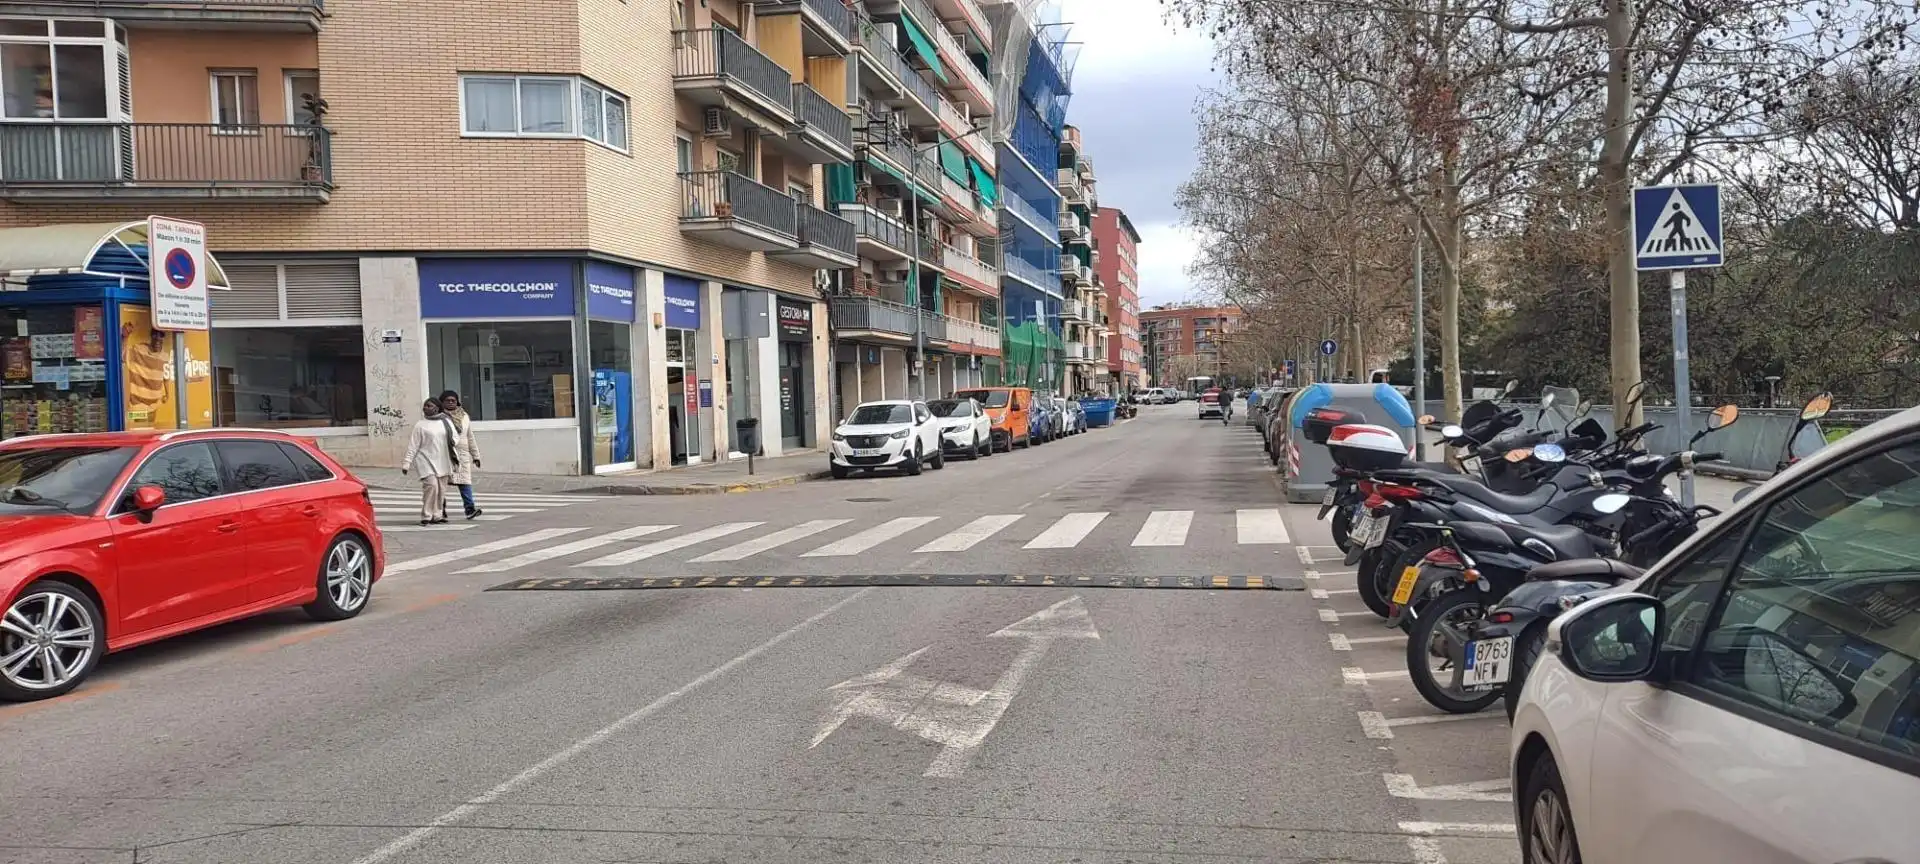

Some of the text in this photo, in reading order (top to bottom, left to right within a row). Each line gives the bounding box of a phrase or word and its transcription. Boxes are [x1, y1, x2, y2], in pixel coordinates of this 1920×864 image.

[439, 282, 554, 293] TCC THECOLCHON
[589, 284, 600, 294] TCC
[780, 305, 802, 320] GESTORIA
[1476, 640, 1509, 661] 8763
[1474, 661, 1499, 681] NFW
